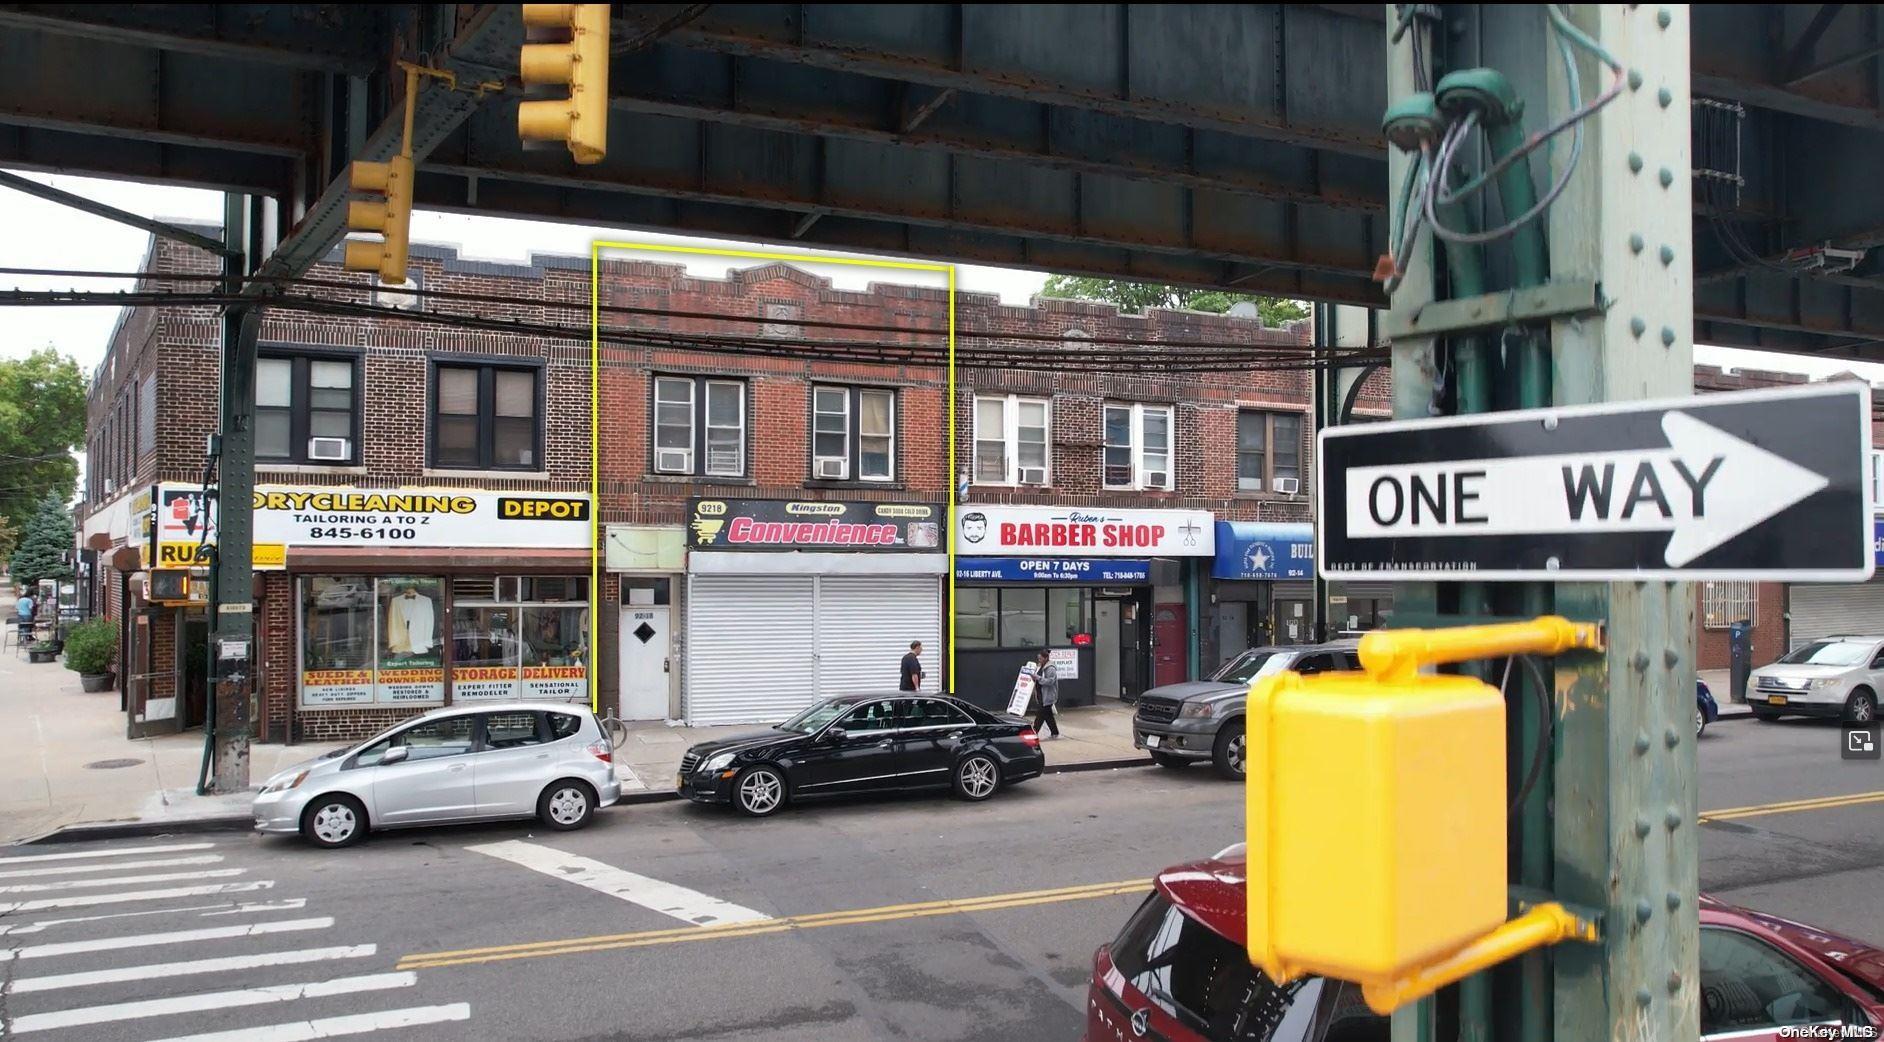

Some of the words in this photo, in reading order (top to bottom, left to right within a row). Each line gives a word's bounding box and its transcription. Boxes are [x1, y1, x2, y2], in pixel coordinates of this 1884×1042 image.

[1368, 470, 1489, 527] ONE
[1562, 455, 1725, 521] WAY
[504, 501, 583, 517] DEPOT
[701, 505, 722, 513] 9218
[791, 503, 841, 513] Kingston
[293, 514, 377, 525] TAILORING
[382, 515, 392, 524] A
[397, 516, 416, 525] TO
[421, 516, 430, 525] Z
[310, 527, 416, 540] 845-6100
[728, 517, 898, 545] Convenience
[1000, 522, 1094, 547] BARBER
[1102, 524, 1166, 548] SHOP
[1020, 561, 1050, 571] OPEN
[1053, 561, 1060, 571] 7
[1062, 561, 1090, 571] DAYS
[1331, 562, 1355, 571] DEPT
[1361, 562, 1373, 571] OF
[1379, 561, 1477, 571] TRANSPORTATION
[1102, 571, 1113, 579] TEL:
[308, 671, 354, 679] SUEDE
[380, 669, 443, 677] WEDDING
[451, 668, 517, 681] STORAGE
[523, 667, 586, 679] DELIVERY
[304, 678, 371, 686] LEATHER
